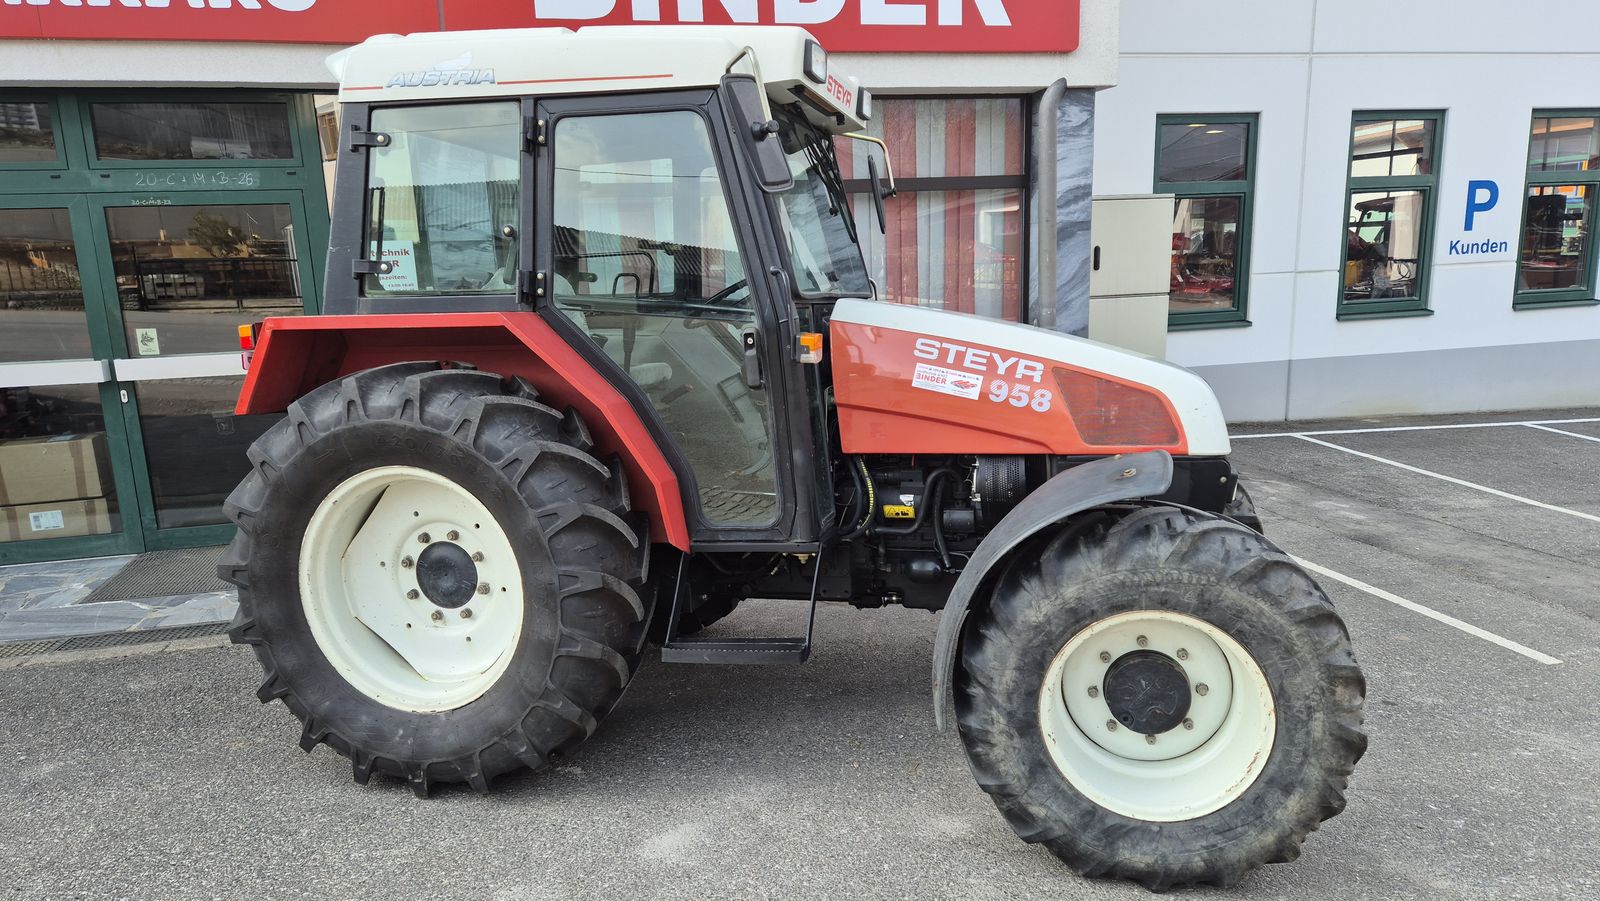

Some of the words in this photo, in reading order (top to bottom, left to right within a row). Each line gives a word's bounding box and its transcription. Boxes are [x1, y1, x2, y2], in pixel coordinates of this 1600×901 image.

[385, 68, 496, 88] AUSTRIA
[827, 74, 852, 108] STEYR
[1464, 180, 1499, 231] P
[370, 249, 410, 257] tchnik
[1449, 238, 1508, 255] Kunden
[913, 338, 1044, 383] STEYR
[989, 380, 1053, 413] 958
